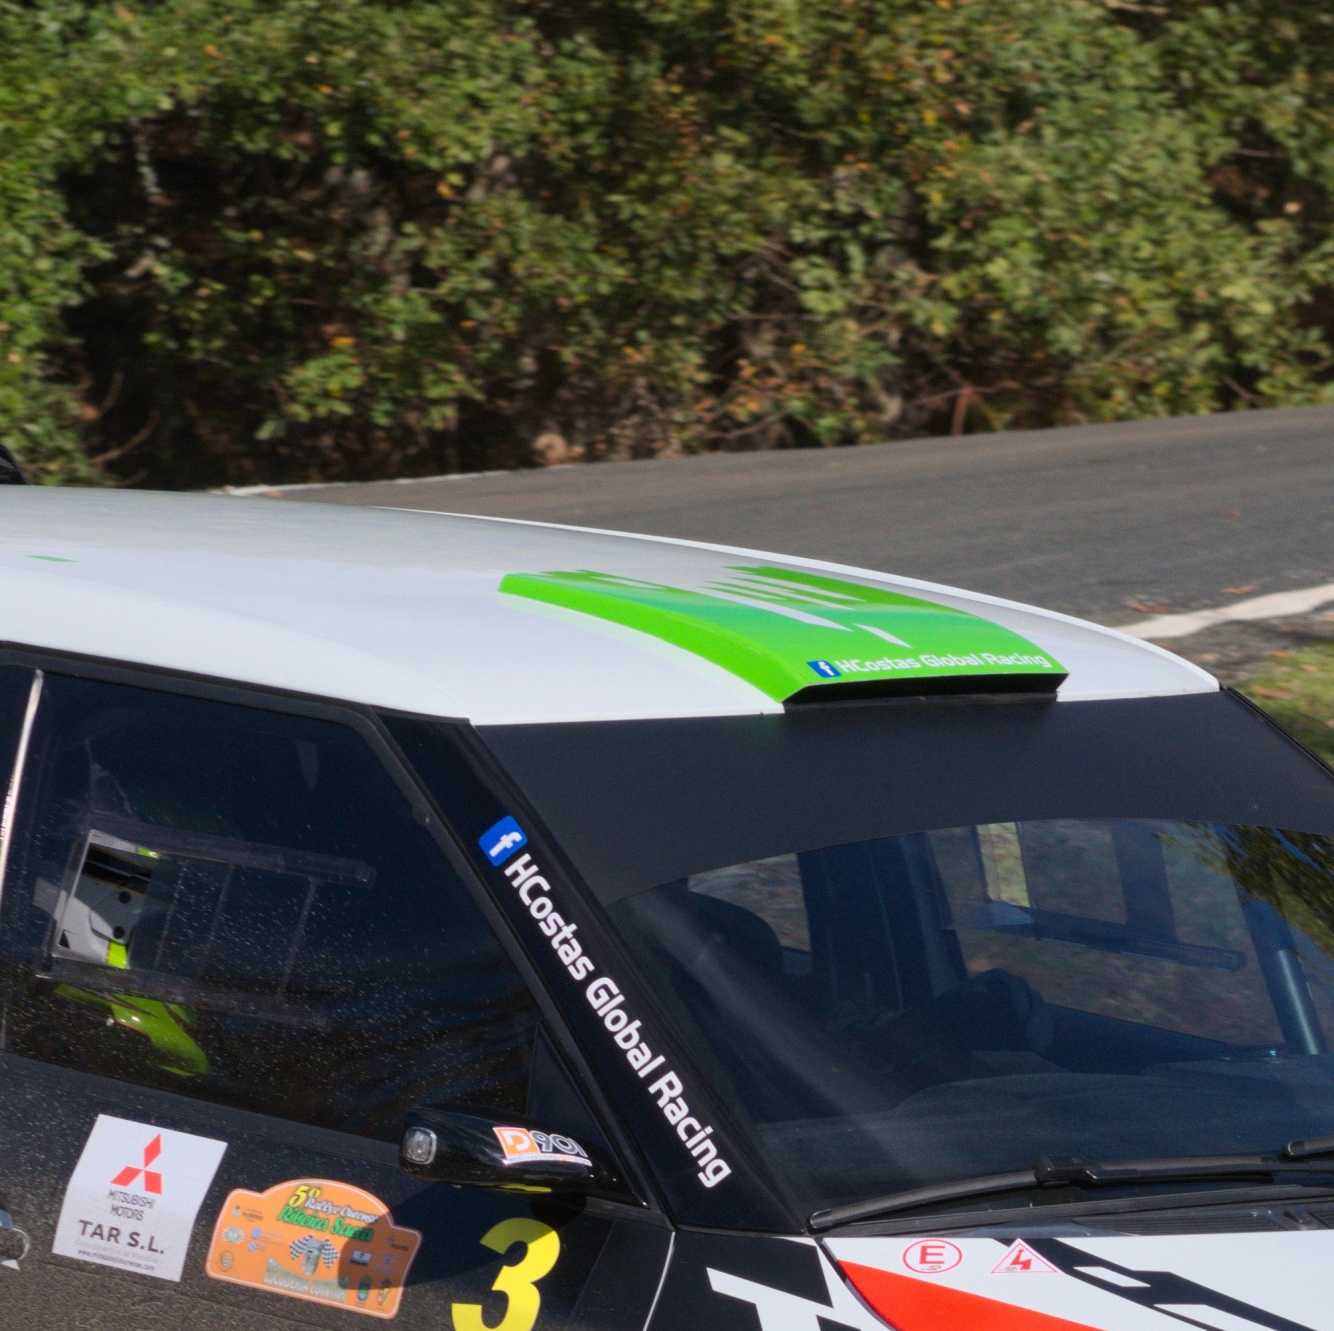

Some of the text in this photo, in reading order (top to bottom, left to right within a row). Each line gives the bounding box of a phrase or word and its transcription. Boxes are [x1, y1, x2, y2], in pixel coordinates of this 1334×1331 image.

[835, 657, 921, 673] HCostas
[919, 653, 984, 668] Global
[981, 652, 1053, 668] Racing
[504, 853, 595, 981] HCostas
[585, 977, 666, 1078] Global
[648, 1071, 732, 1188] Racing
[108, 1190, 156, 1208] MITSUBISHI
[110, 1205, 144, 1221] MOTORS
[79, 1220, 121, 1244] TAR
[127, 1232, 164, 1254] S.L.
[919, 1245, 945, 1265] E
